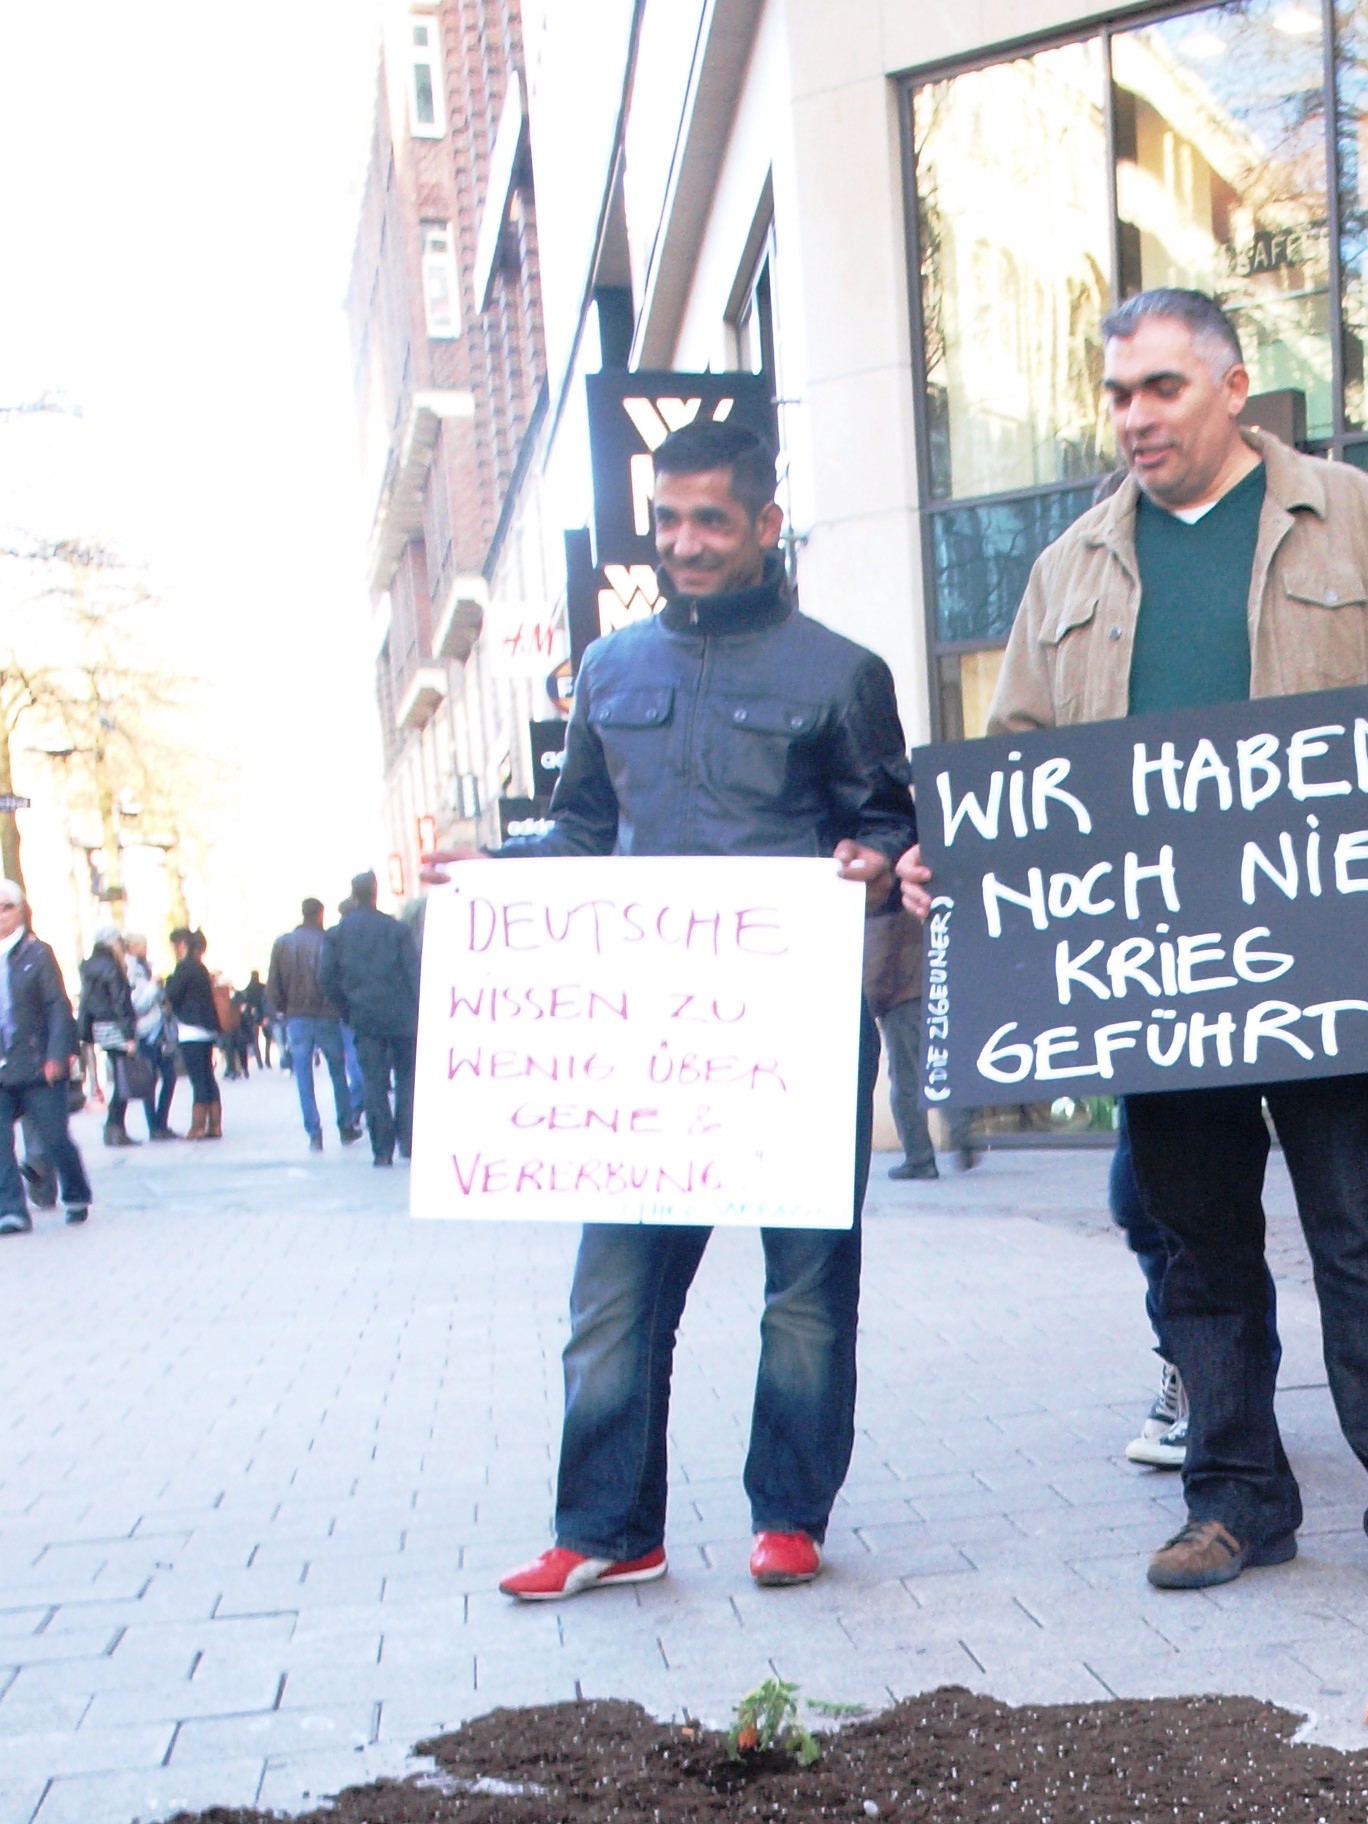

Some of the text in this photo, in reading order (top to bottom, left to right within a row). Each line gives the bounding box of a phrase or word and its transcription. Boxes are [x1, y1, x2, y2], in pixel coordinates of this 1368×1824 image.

[982, 845, 1181, 938] NOCH
[448, 982, 748, 1023] WISSEN ZU
[446, 1038, 788, 1092] WENIG ÜBER
[509, 1102, 723, 1136] GENE &
